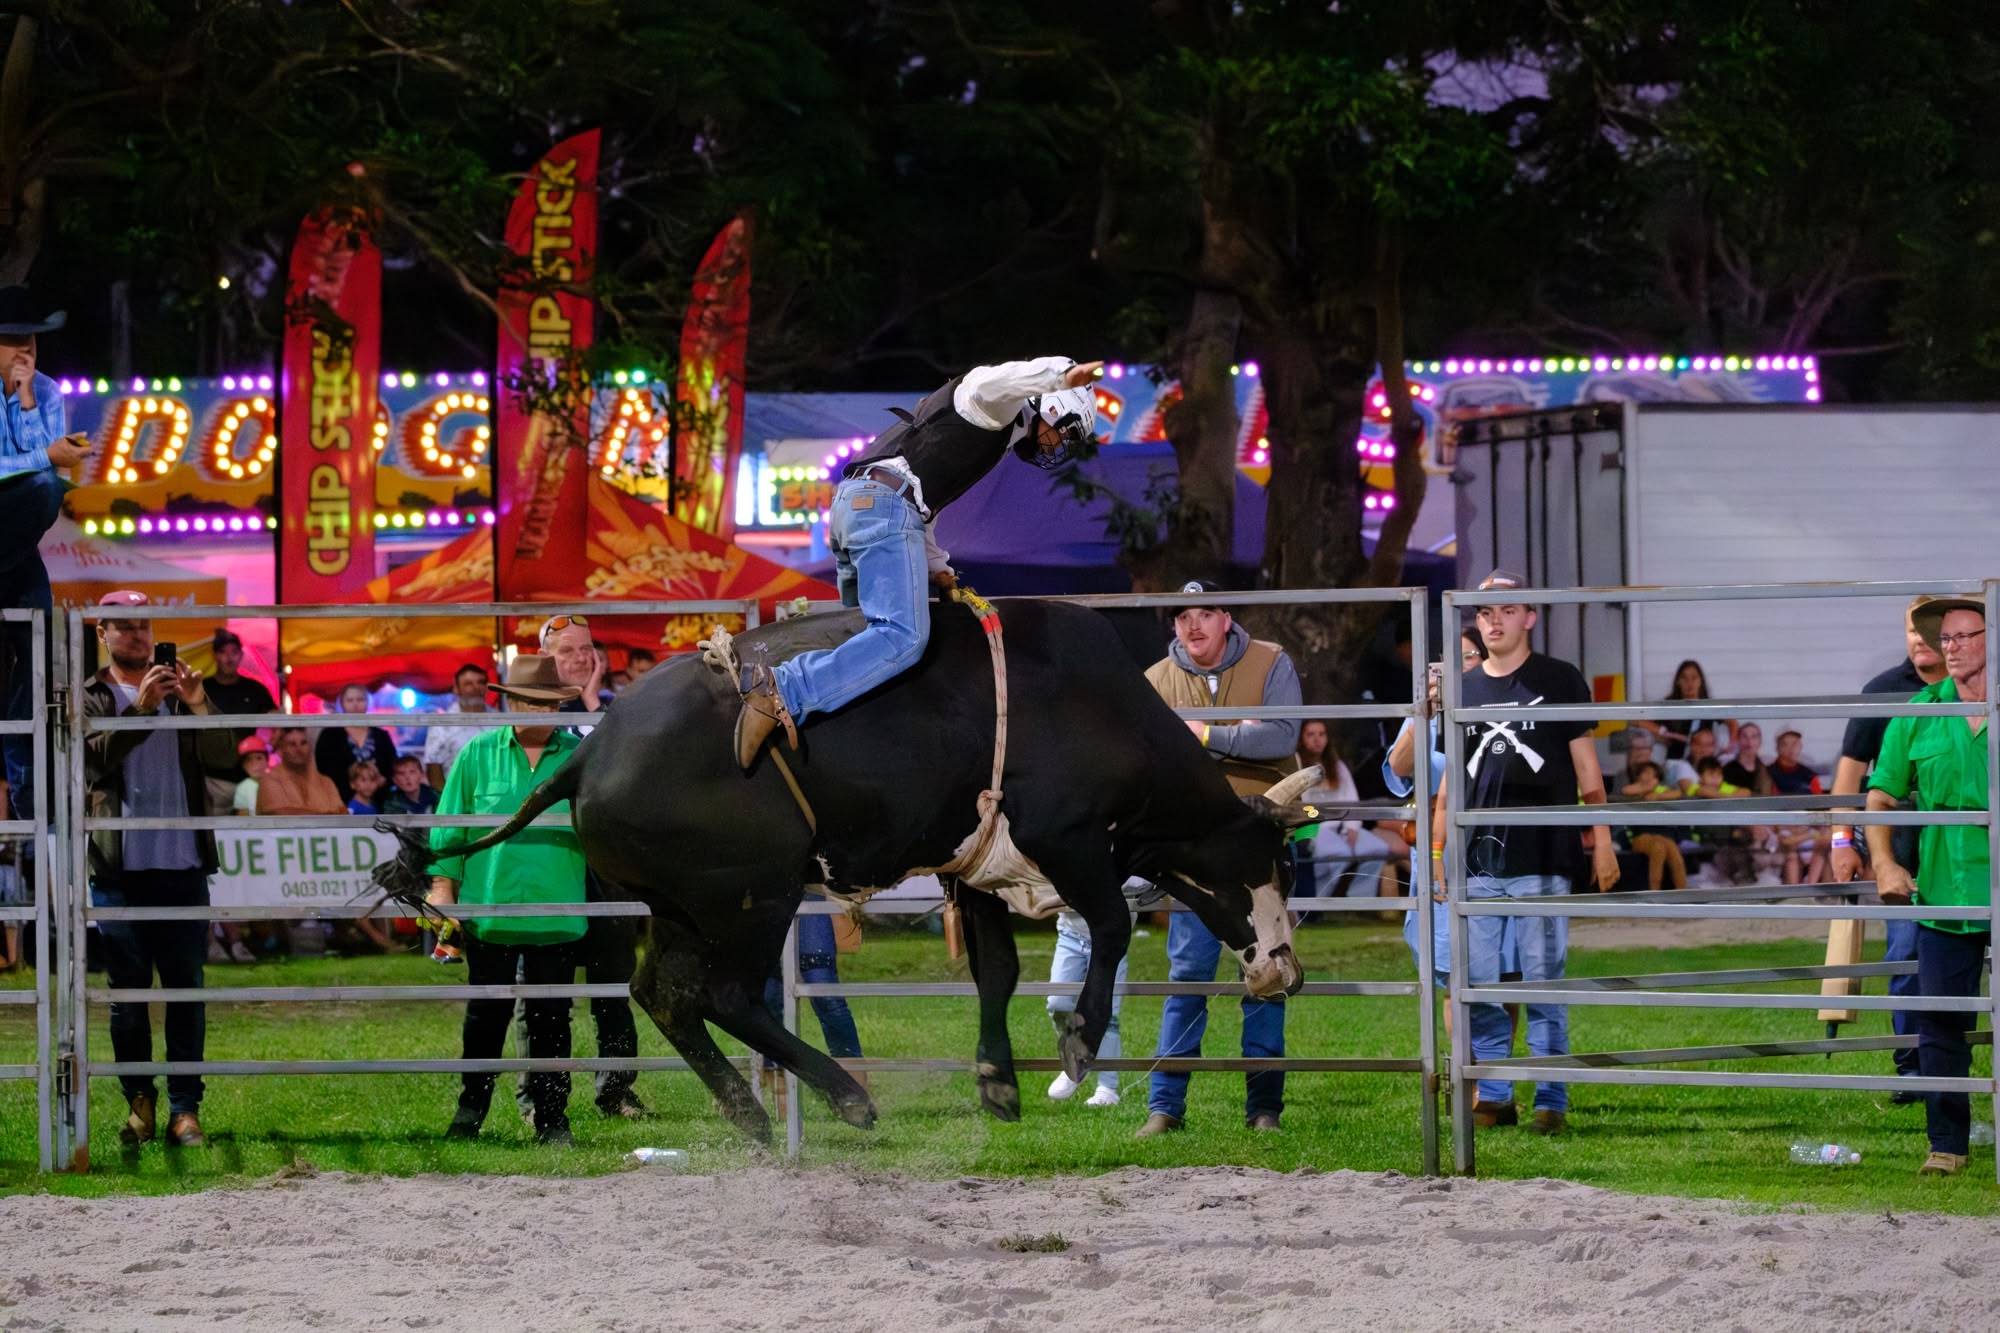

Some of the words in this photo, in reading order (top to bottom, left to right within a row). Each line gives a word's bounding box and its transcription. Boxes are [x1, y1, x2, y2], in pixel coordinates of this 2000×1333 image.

[533, 157, 577, 281] STICK
[528, 296, 571, 398] HIP
[308, 464, 350, 577] CHIP
[781, 482, 838, 510] SH
[276, 835, 377, 875] FIELD
[281, 881, 318, 898] 0403
[322, 880, 347, 896] 021
